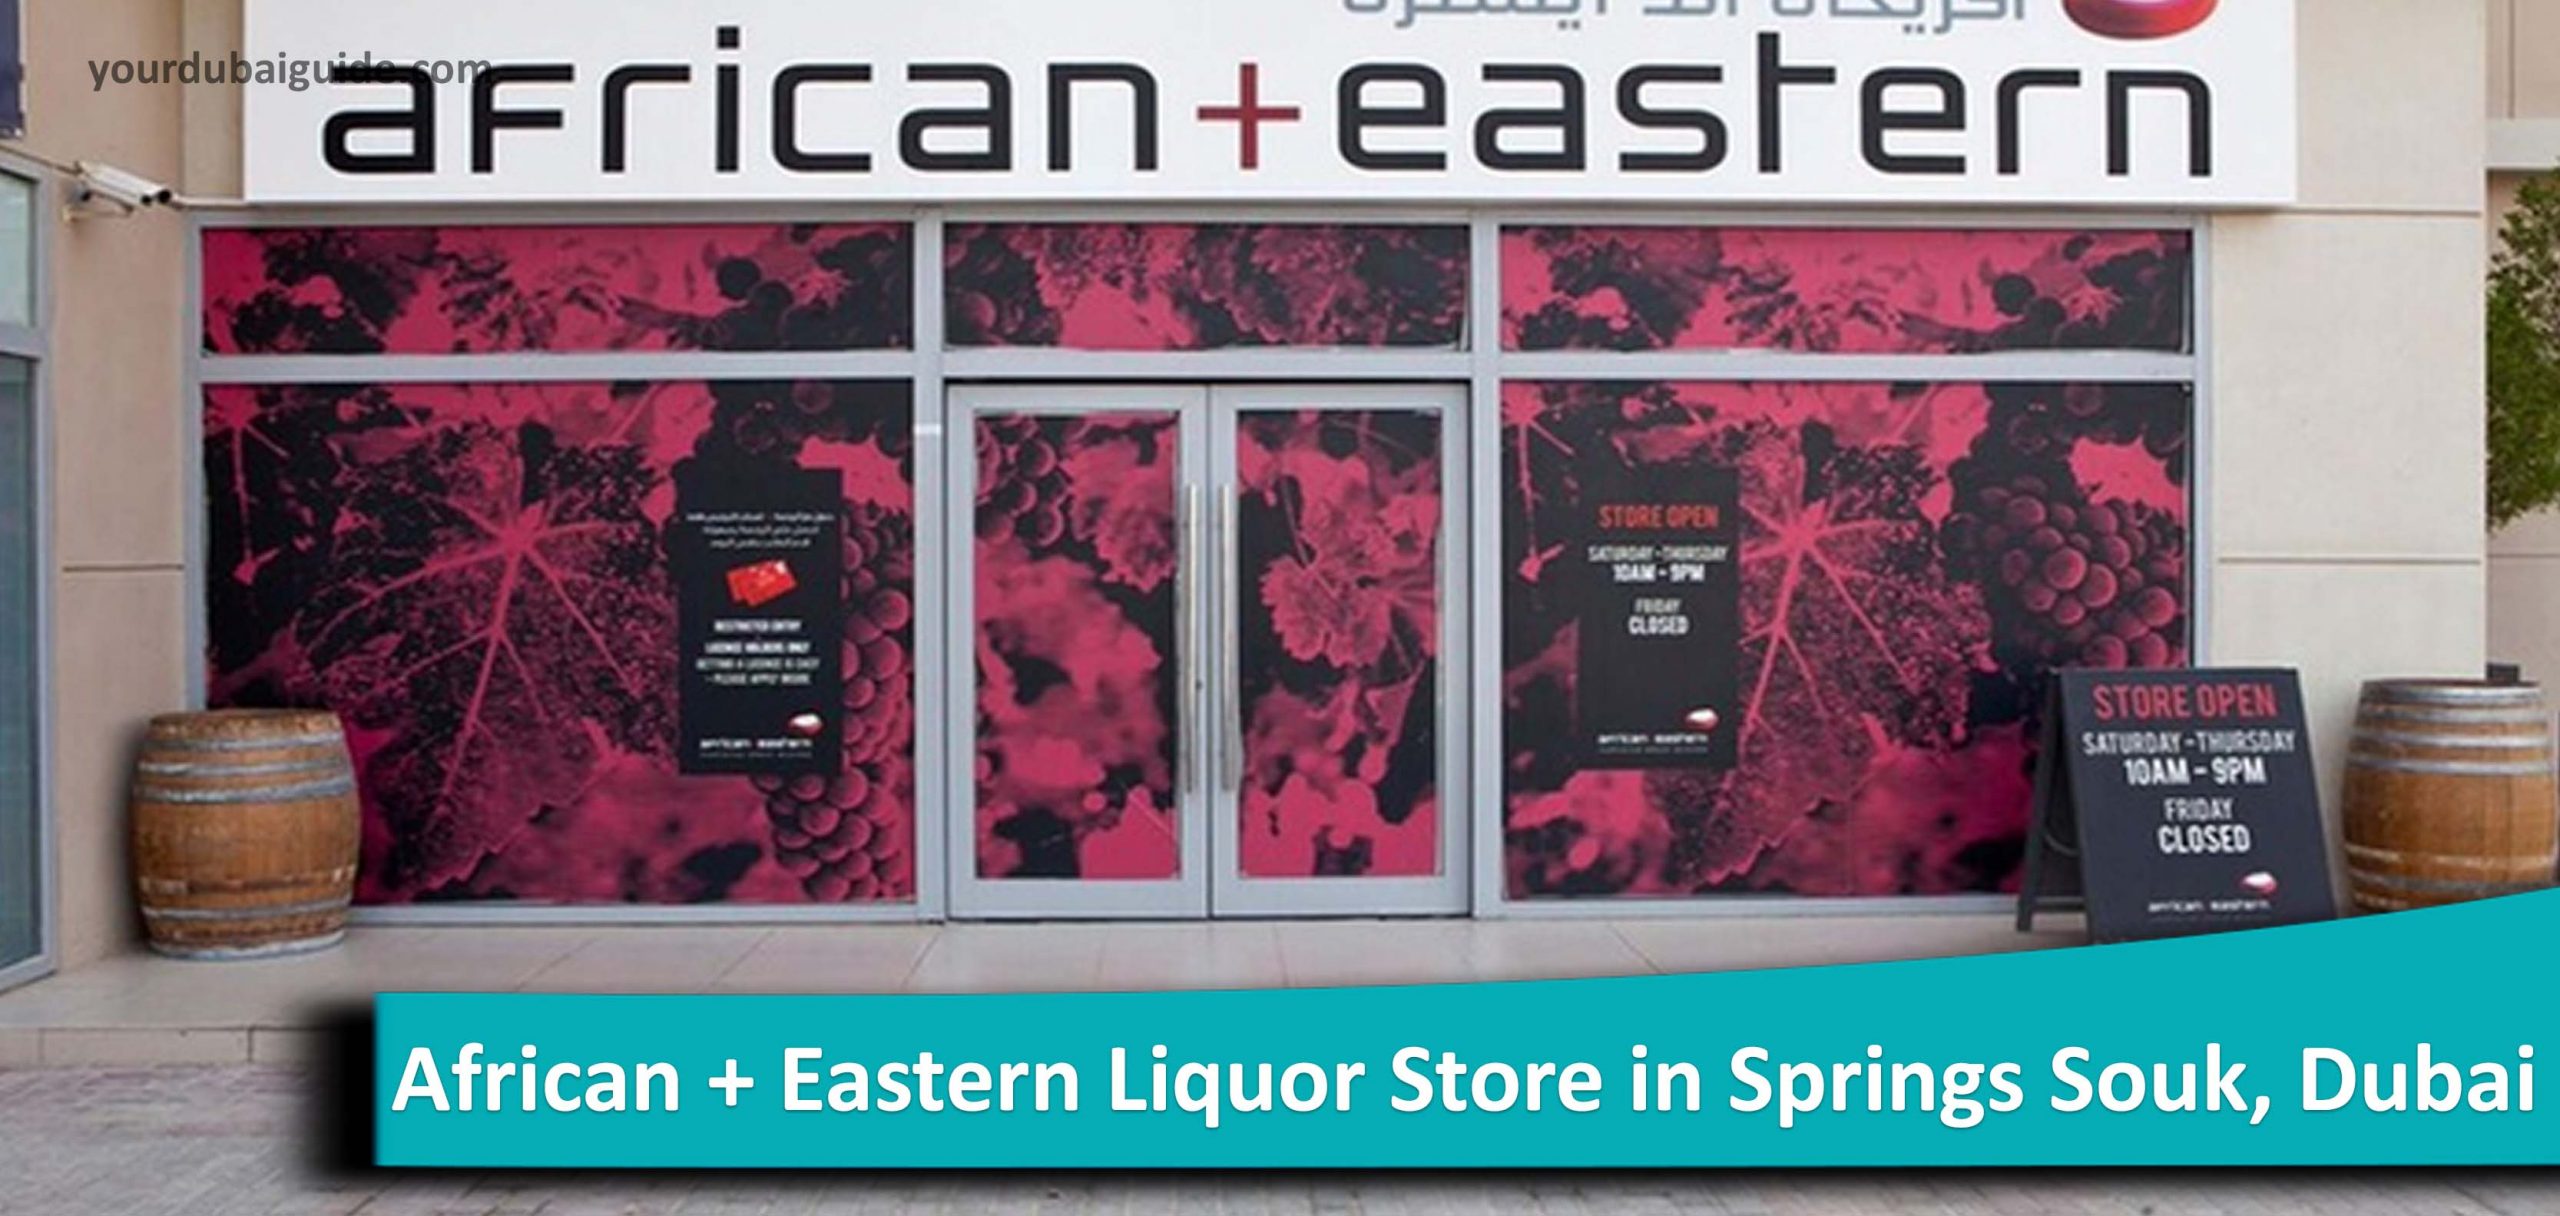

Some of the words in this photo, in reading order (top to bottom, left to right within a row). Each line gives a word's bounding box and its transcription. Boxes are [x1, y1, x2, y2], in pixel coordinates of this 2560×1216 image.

[1598, 505, 1663, 529] STORE
[1666, 505, 1719, 529] OPEN
[1613, 563, 1656, 582] 10AM
[1635, 599, 1682, 613] FRIDAY
[1628, 616, 1689, 635] CLOSED
[2093, 683, 2191, 720] STORE
[2196, 682, 2278, 718] OPEN
[2082, 732, 2182, 755] SATURDAY
[2123, 757, 2190, 786] 10AM
[2163, 799, 2234, 821] FRIDAY
[2158, 825, 2251, 854] CLOSED
